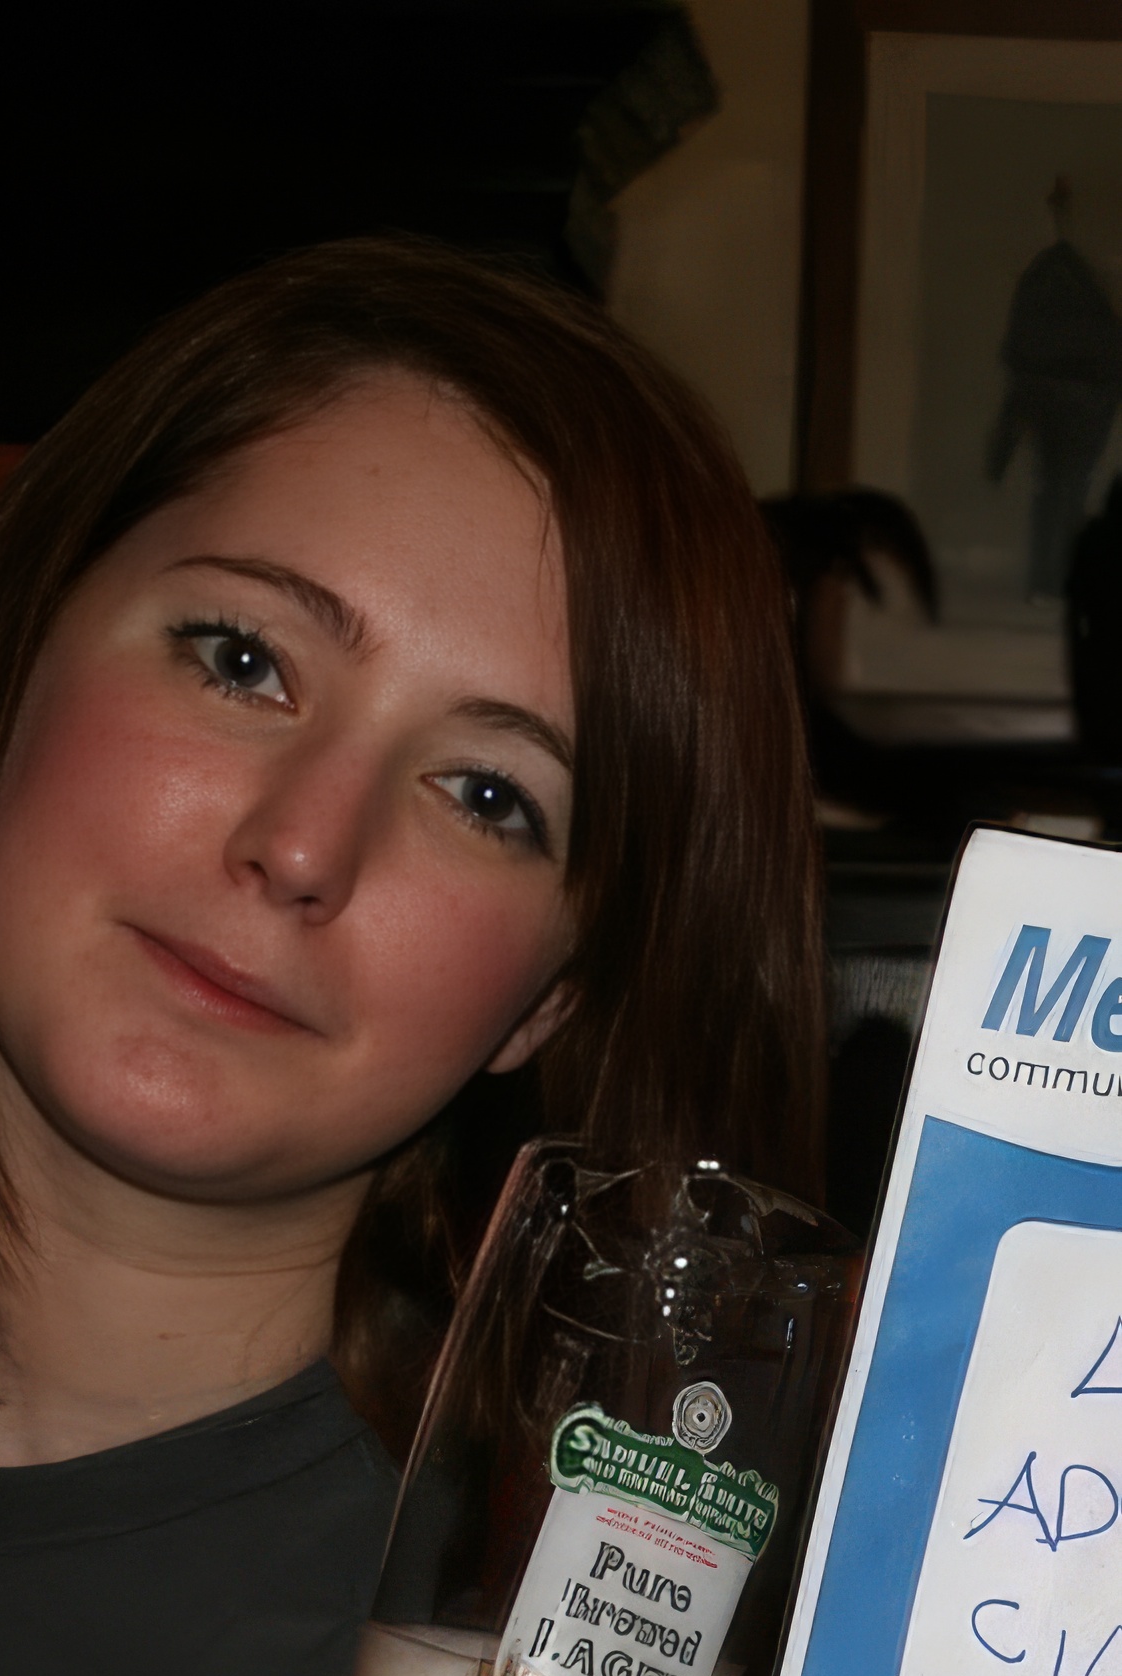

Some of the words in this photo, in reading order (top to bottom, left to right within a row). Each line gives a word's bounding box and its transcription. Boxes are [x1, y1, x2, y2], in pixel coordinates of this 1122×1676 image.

[981, 924, 1122, 1052] Me
[967, 1052, 1122, 1096] commu
[963, 1451, 1122, 1552] AD
[589, 1540, 692, 1613] Pure
